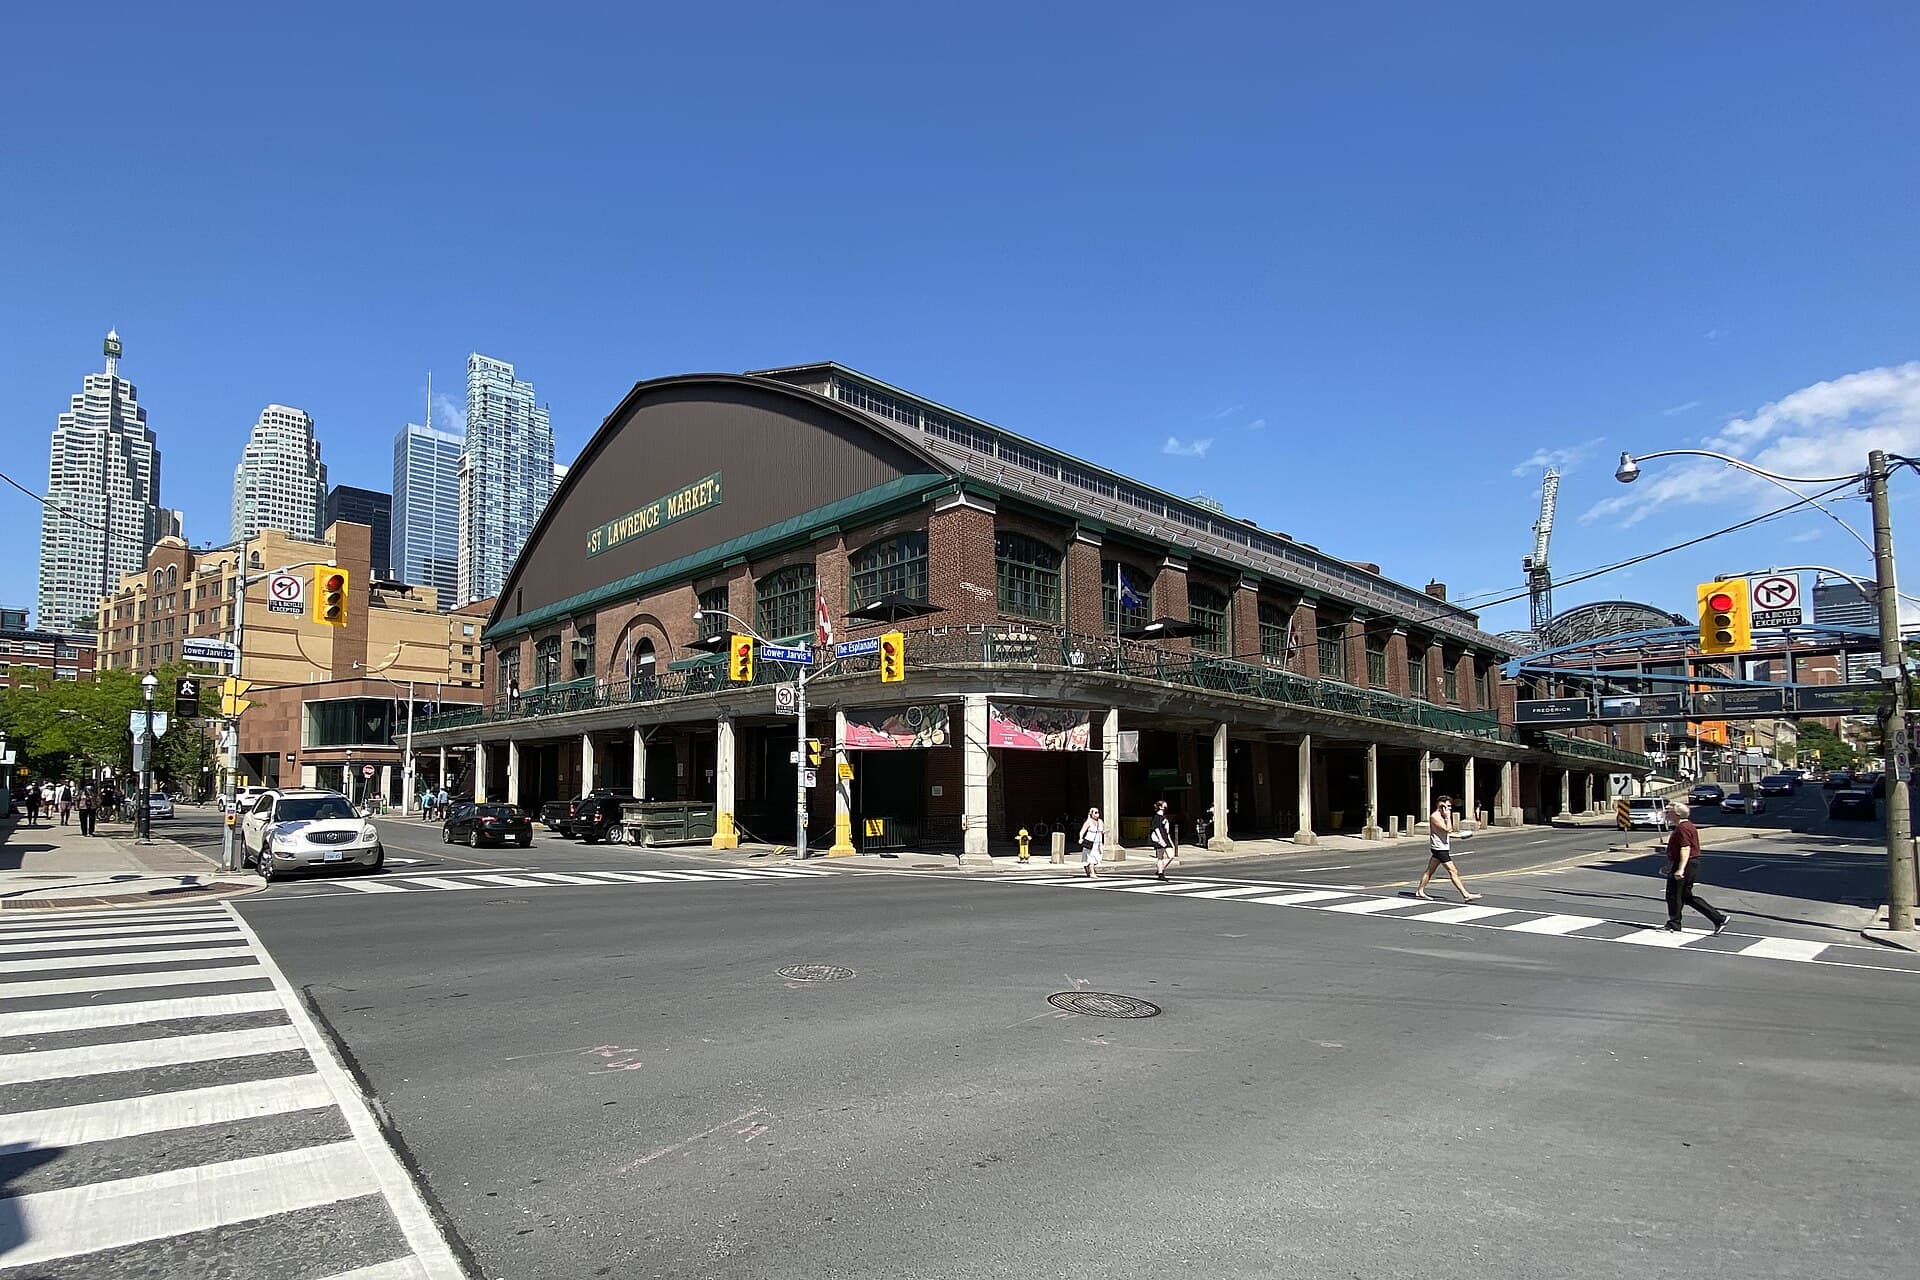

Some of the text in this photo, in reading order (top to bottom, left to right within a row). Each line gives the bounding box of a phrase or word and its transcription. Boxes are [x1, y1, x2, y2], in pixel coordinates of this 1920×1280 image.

[591, 479, 714, 552] ST LAWRENCE MARKET
[1771, 610, 1801, 619] BICYCLES
[1755, 617, 1799, 627] EXCEPTED
[183, 646, 205, 655] Lower
[838, 639, 878, 654] The Esplanade
[764, 648, 785, 658] Lower
[786, 650, 807, 660] Jarvis
